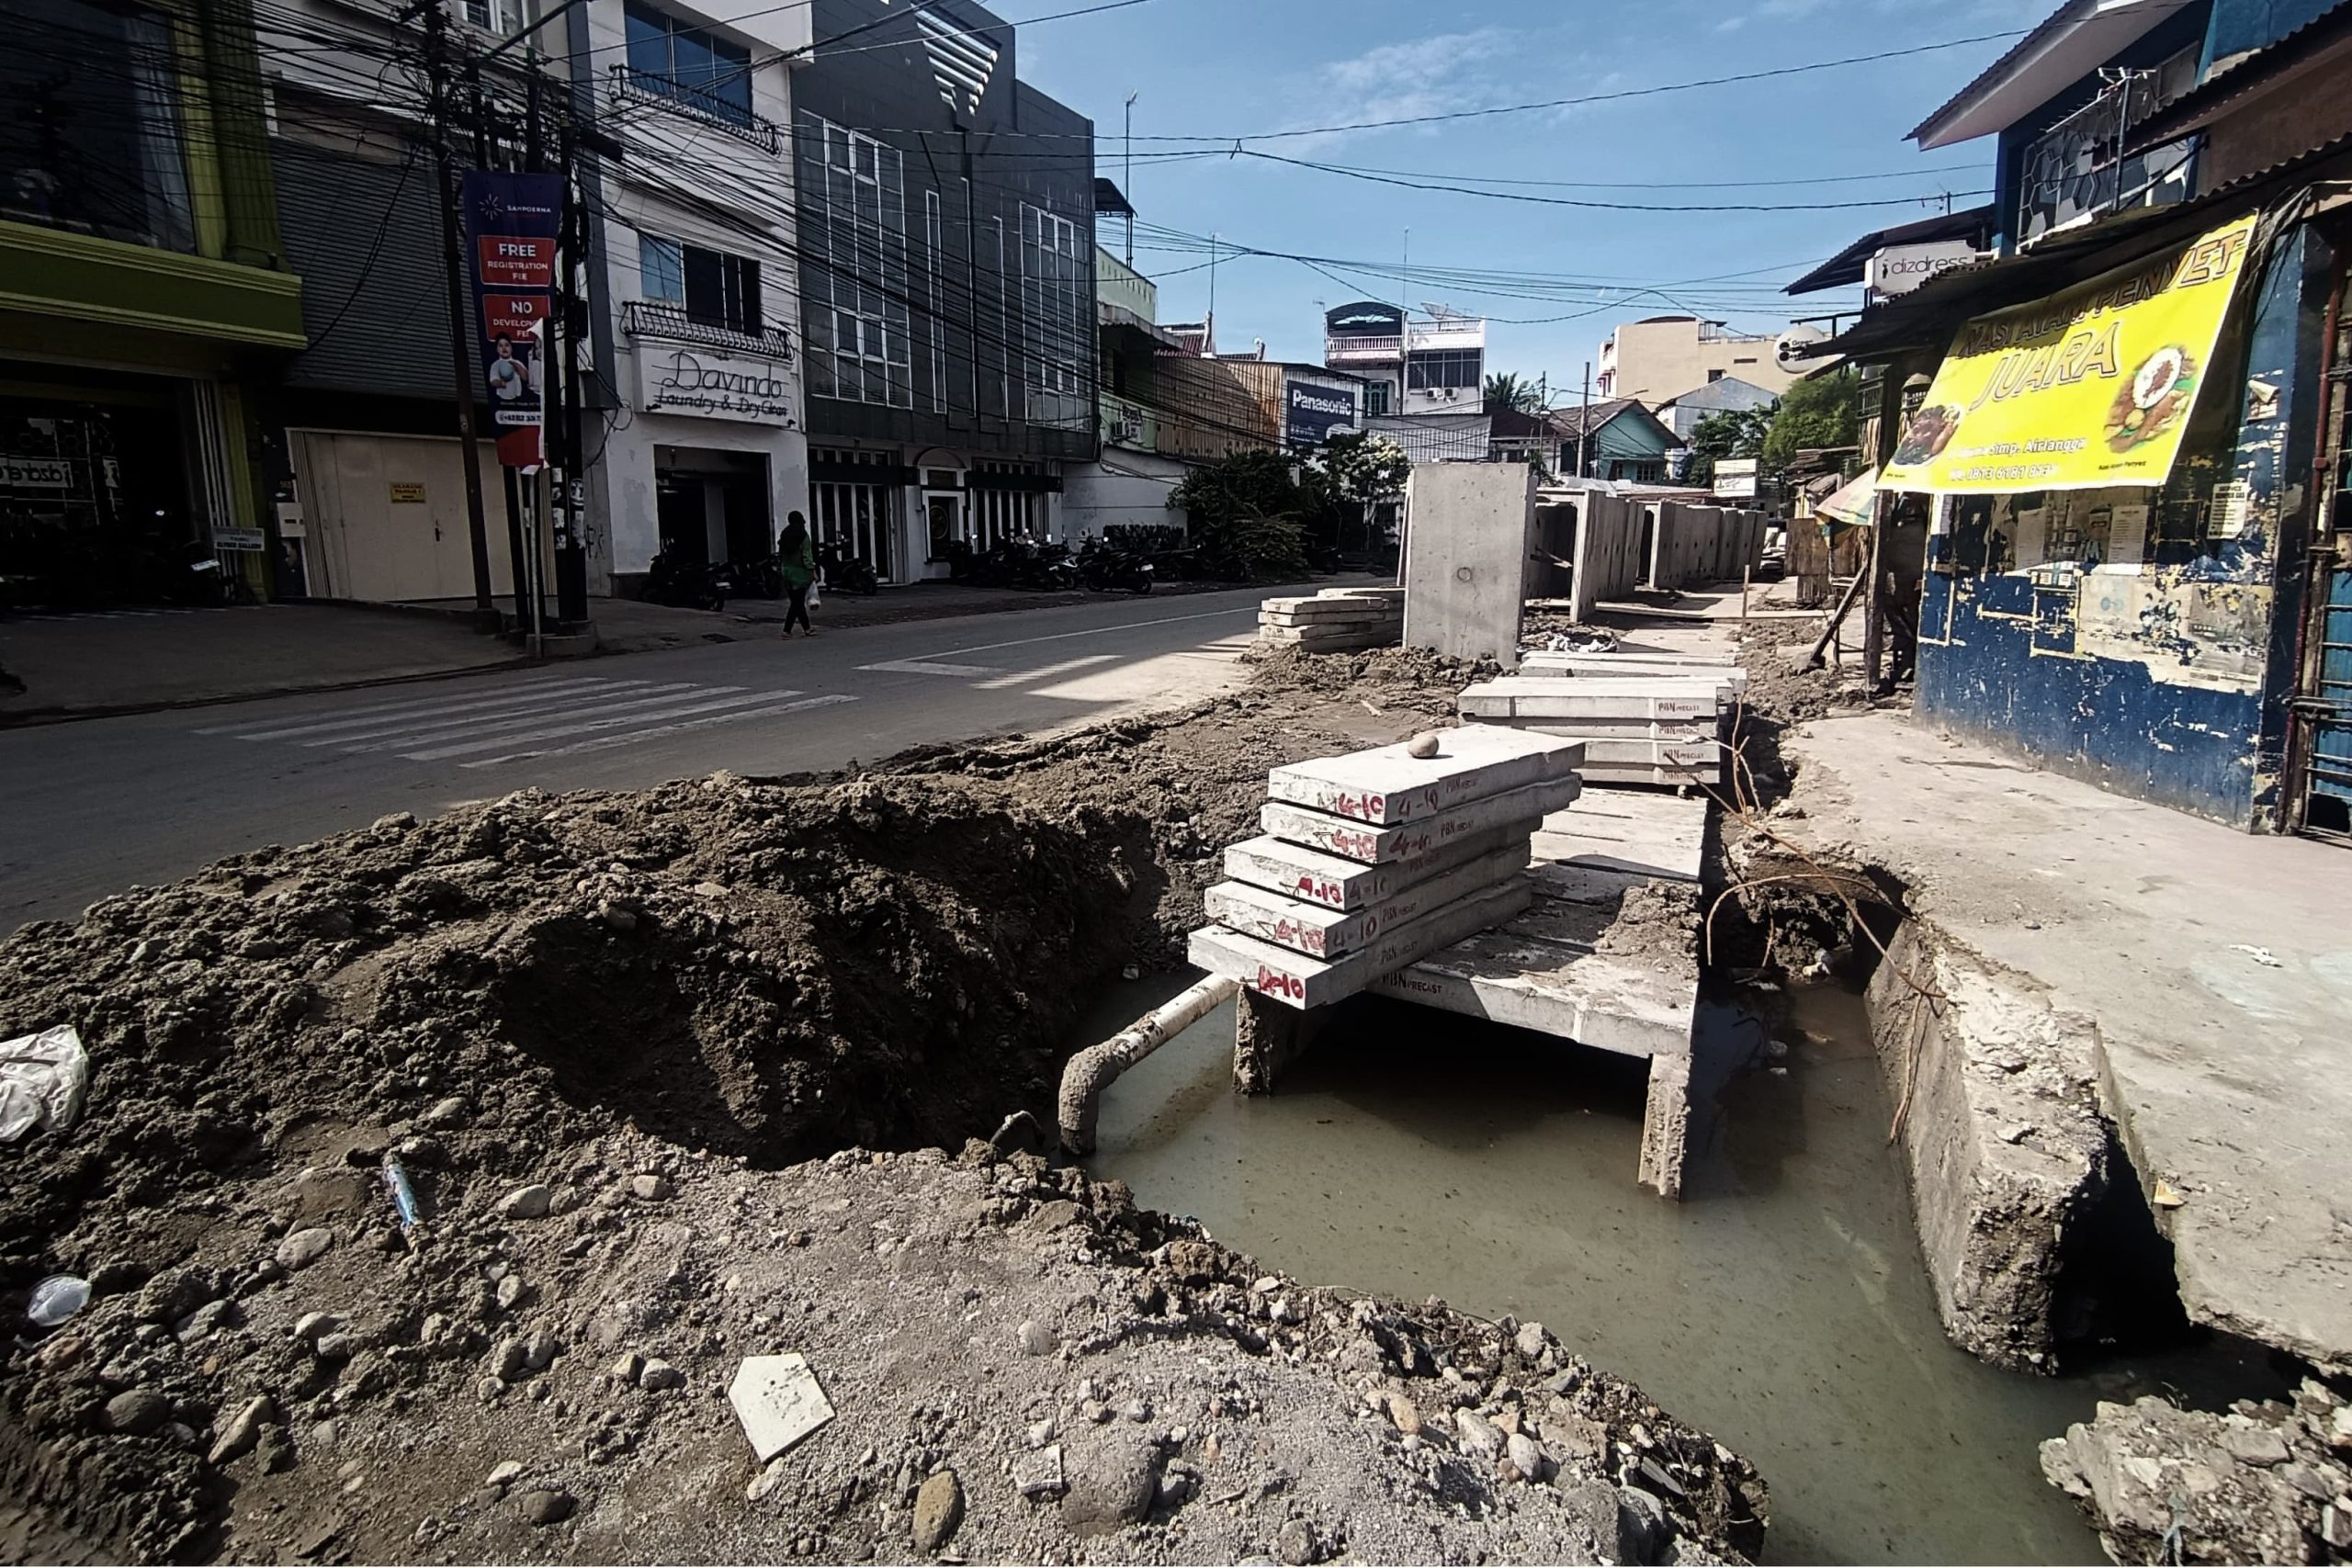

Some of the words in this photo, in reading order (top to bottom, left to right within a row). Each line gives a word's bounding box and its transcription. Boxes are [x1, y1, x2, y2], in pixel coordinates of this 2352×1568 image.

[507, 205, 551, 214] SAMPOERNA
[499, 243, 537, 257] FREE
[487, 260, 548, 270] REGISTRATION
[1891, 255, 1969, 275] dizdress
[2094, 229, 2249, 316] PENYET
[511, 301, 533, 314] NO
[662, 349, 782, 399] Davindo
[1968, 321, 2121, 412] JUARA
[659, 387, 716, 414] Laundry
[721, 394, 733, 411] &
[1293, 389, 1351, 416] Panasonic
